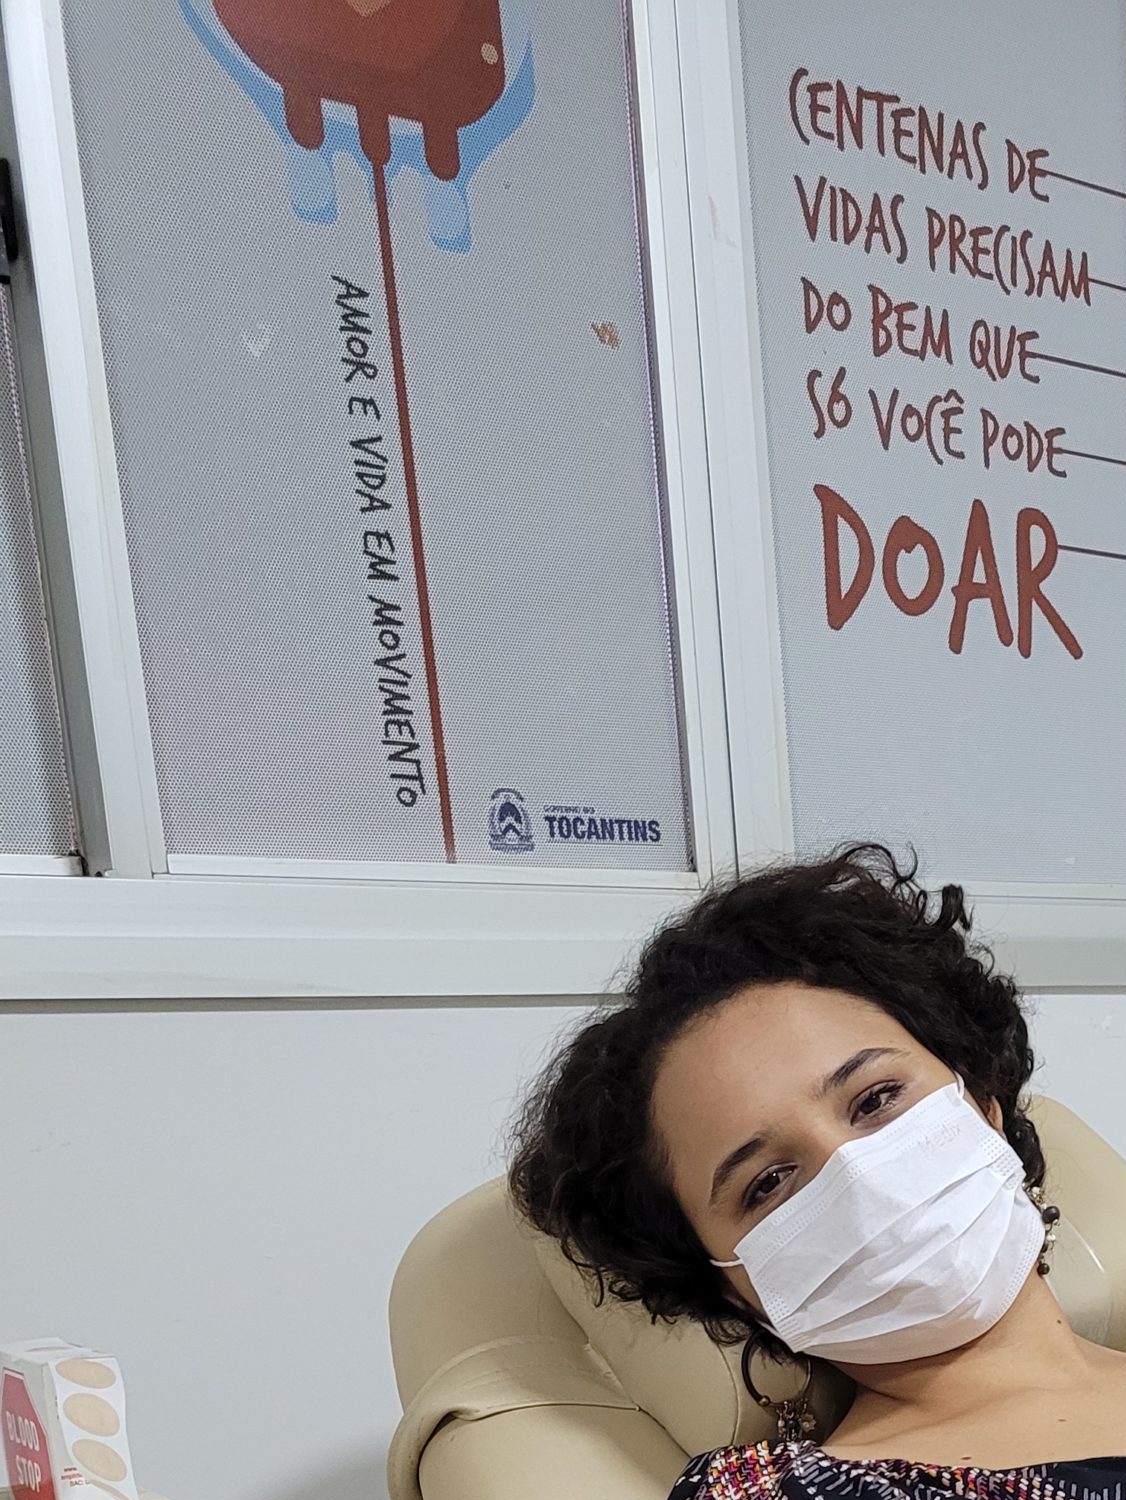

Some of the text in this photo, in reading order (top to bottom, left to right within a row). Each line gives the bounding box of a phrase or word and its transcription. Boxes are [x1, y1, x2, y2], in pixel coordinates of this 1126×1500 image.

[789, 66, 1050, 203] CENTENAS DE
[794, 174, 1091, 306] VIDAS PRECISAM
[801, 276, 1040, 384] DO BEM QUE
[806, 366, 1068, 479] SÓ VOCÊ PODE
[330, 275, 426, 808] AMOR E VIDA EM MOVIMENTO
[813, 484, 1084, 660] DOAR
[543, 816, 662, 842] TOCANTINS
[6, 1411, 40, 1452] BLOOD
[15, 1455, 42, 1492] STOP
